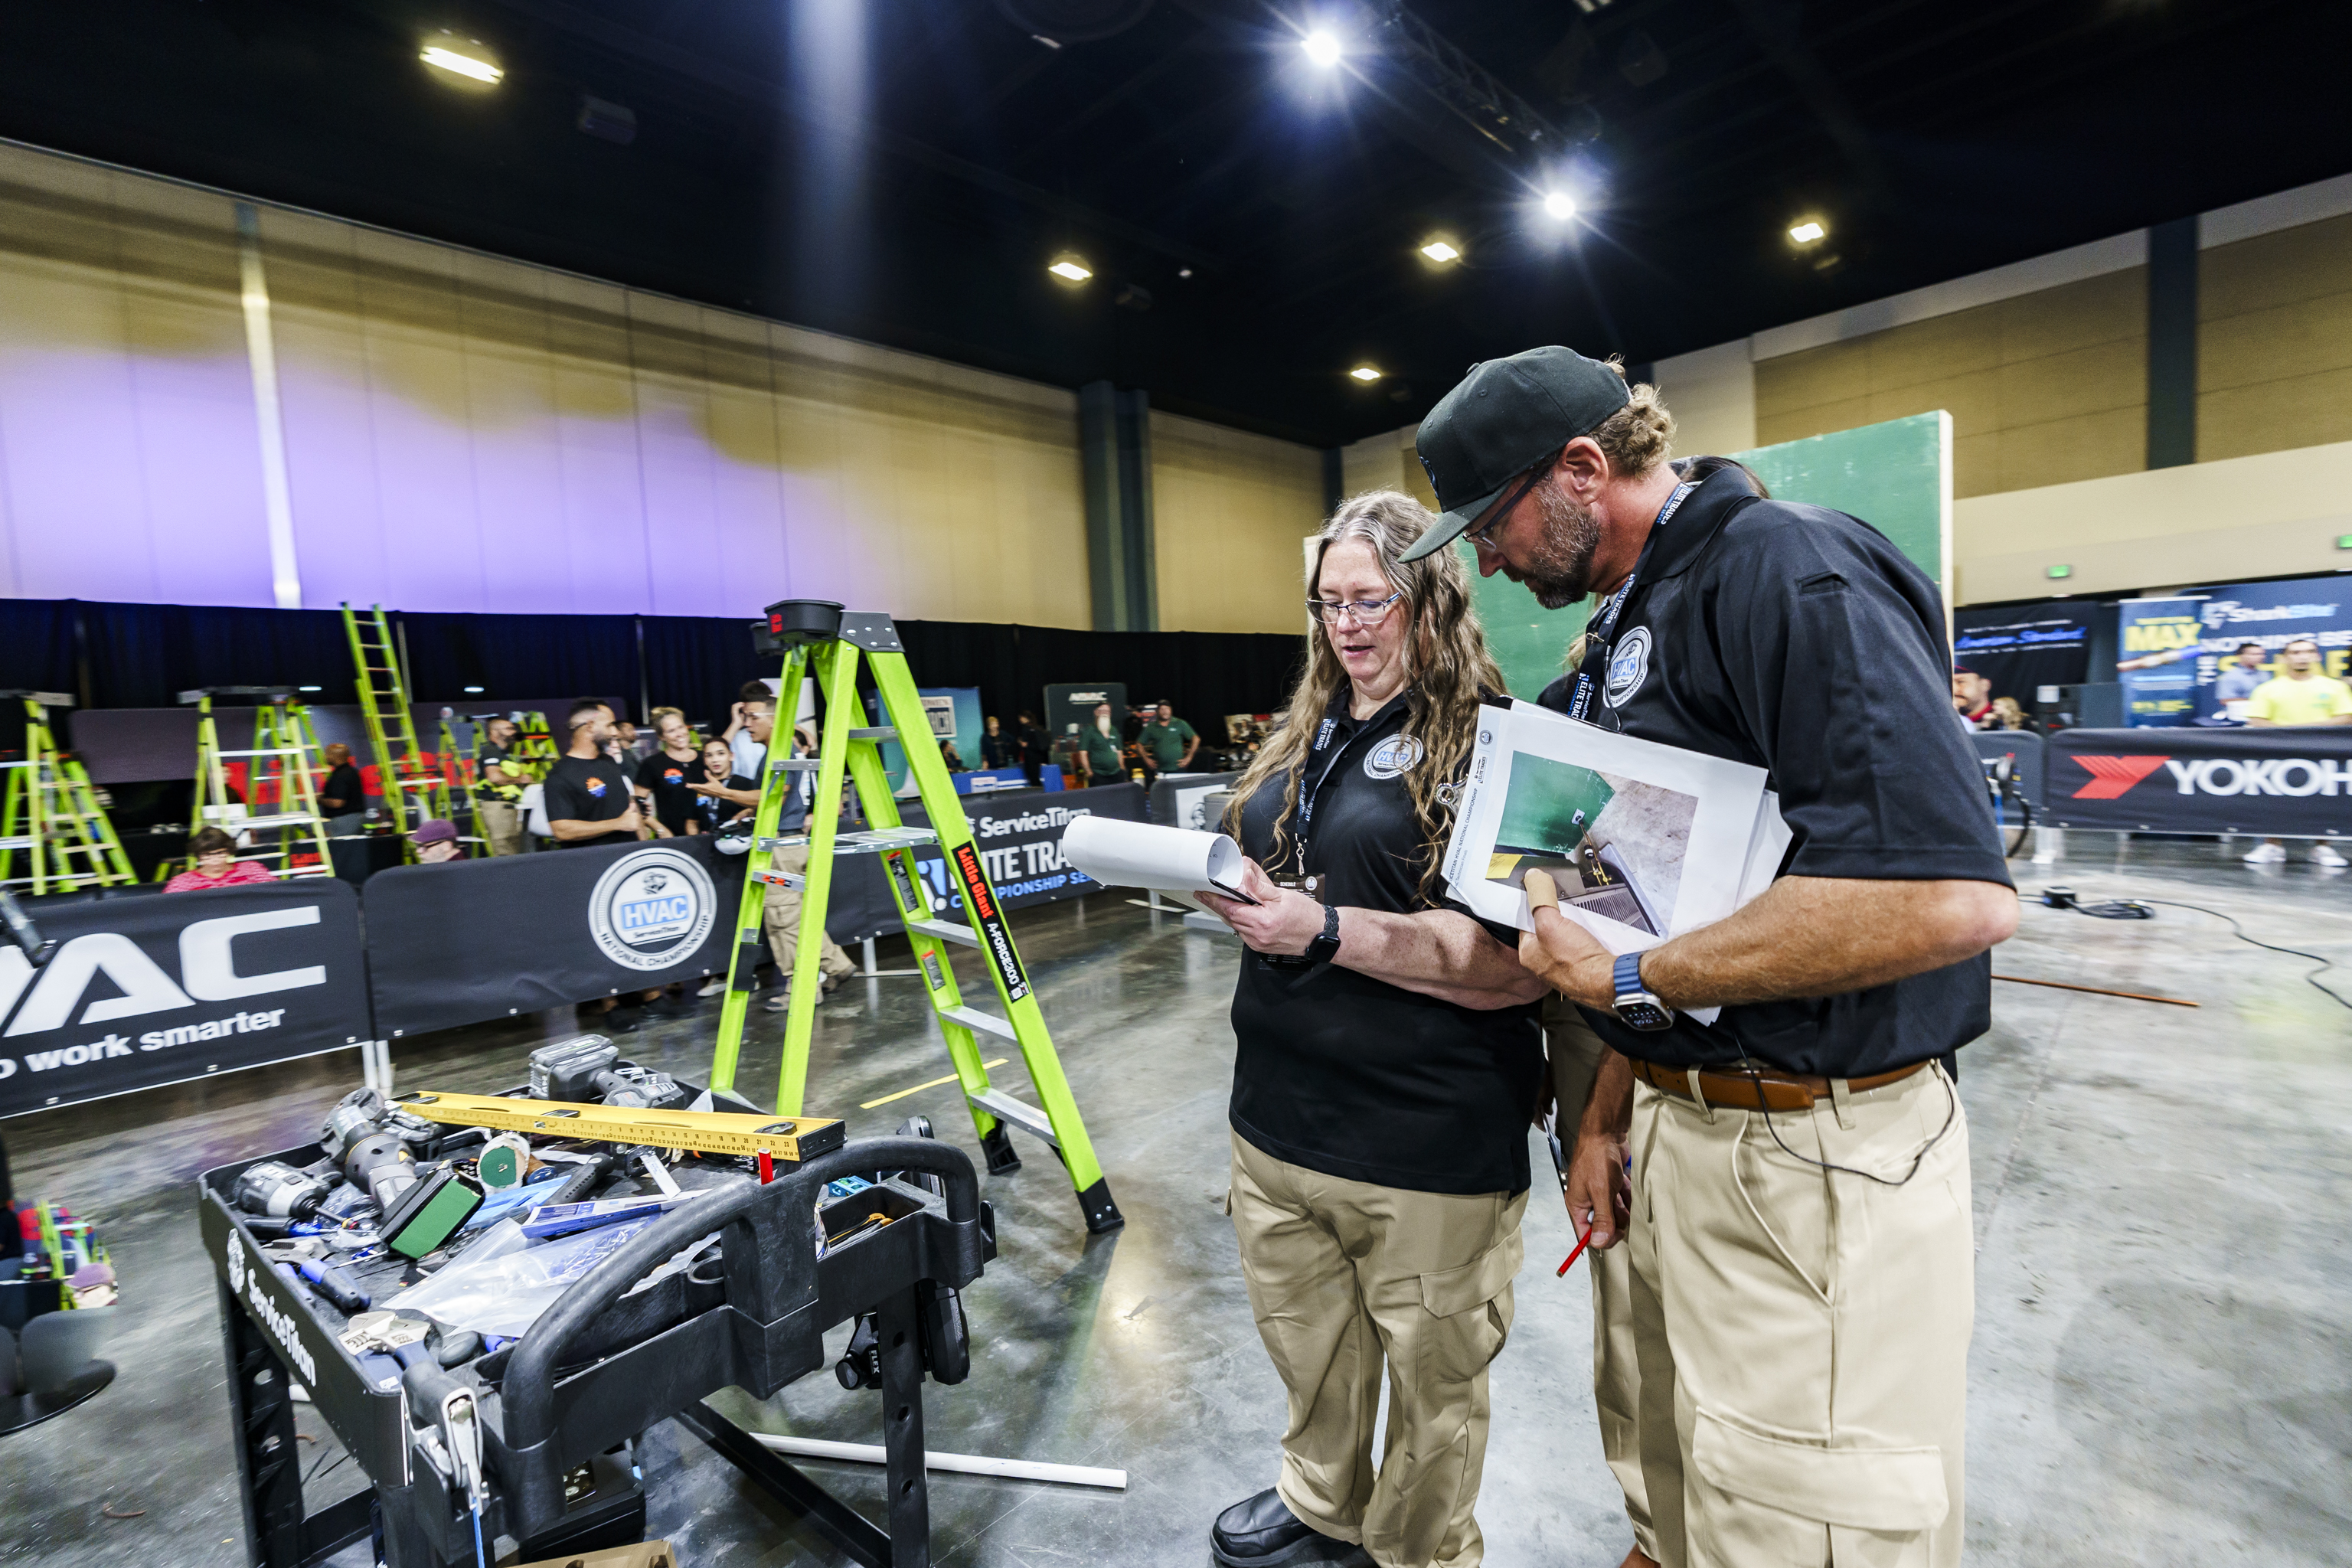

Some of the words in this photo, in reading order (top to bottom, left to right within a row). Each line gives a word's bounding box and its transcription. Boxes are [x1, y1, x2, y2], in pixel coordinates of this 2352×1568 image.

[2125, 623, 2203, 652] MAX
[1576, 681, 1588, 701] ELITE
[1315, 734, 1326, 750] TRADES
[1321, 723, 1331, 734] ELITE
[1459, 824, 1469, 846] NATIONAL
[1465, 788, 1478, 823] CHAMPIONSHIP
[957, 847, 978, 884] Little
[972, 882, 995, 919] Giant
[623, 897, 688, 928] HVAC
[24, 1034, 133, 1072] work
[139, 1008, 286, 1051] smarter
[247, 1268, 317, 1387] ServiceTitan
[870, 1350, 880, 1374] FLEX
